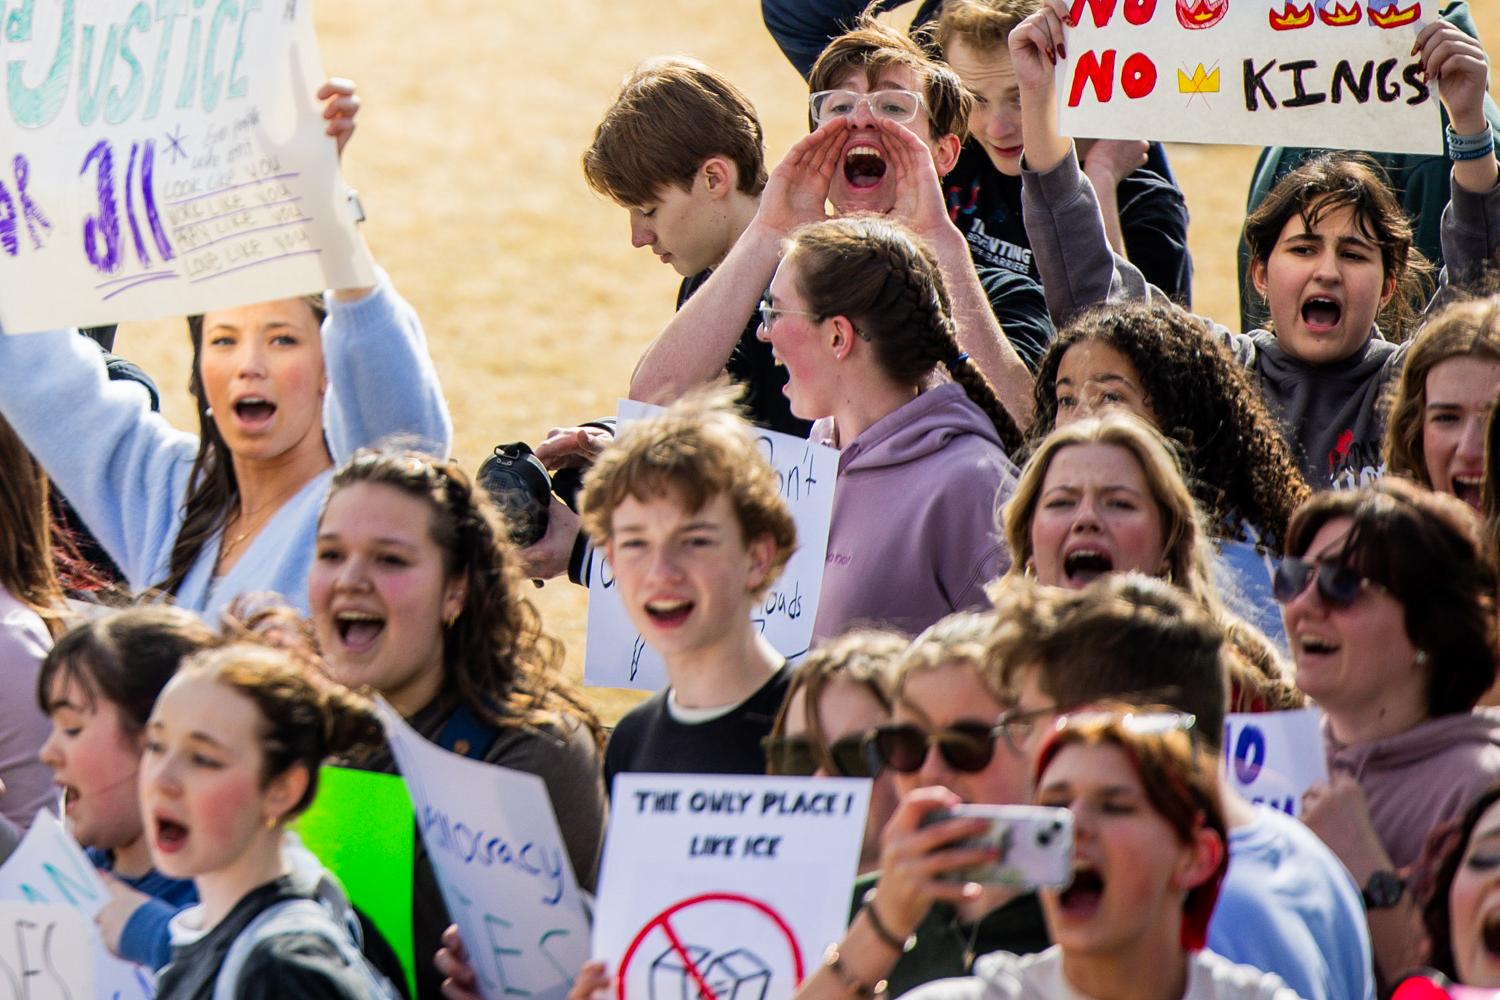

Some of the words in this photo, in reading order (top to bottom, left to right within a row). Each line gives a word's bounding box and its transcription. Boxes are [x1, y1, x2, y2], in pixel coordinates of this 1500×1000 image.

[1068, 49, 1157, 107] NO
[1242, 57, 1430, 111] KINGS
[635, 791, 681, 813] THE
[689, 792, 752, 813] ONLY
[761, 792, 837, 814] PLACE
[844, 793, 854, 815] I
[688, 835, 737, 858] LIKE
[742, 835, 782, 859] ICE
